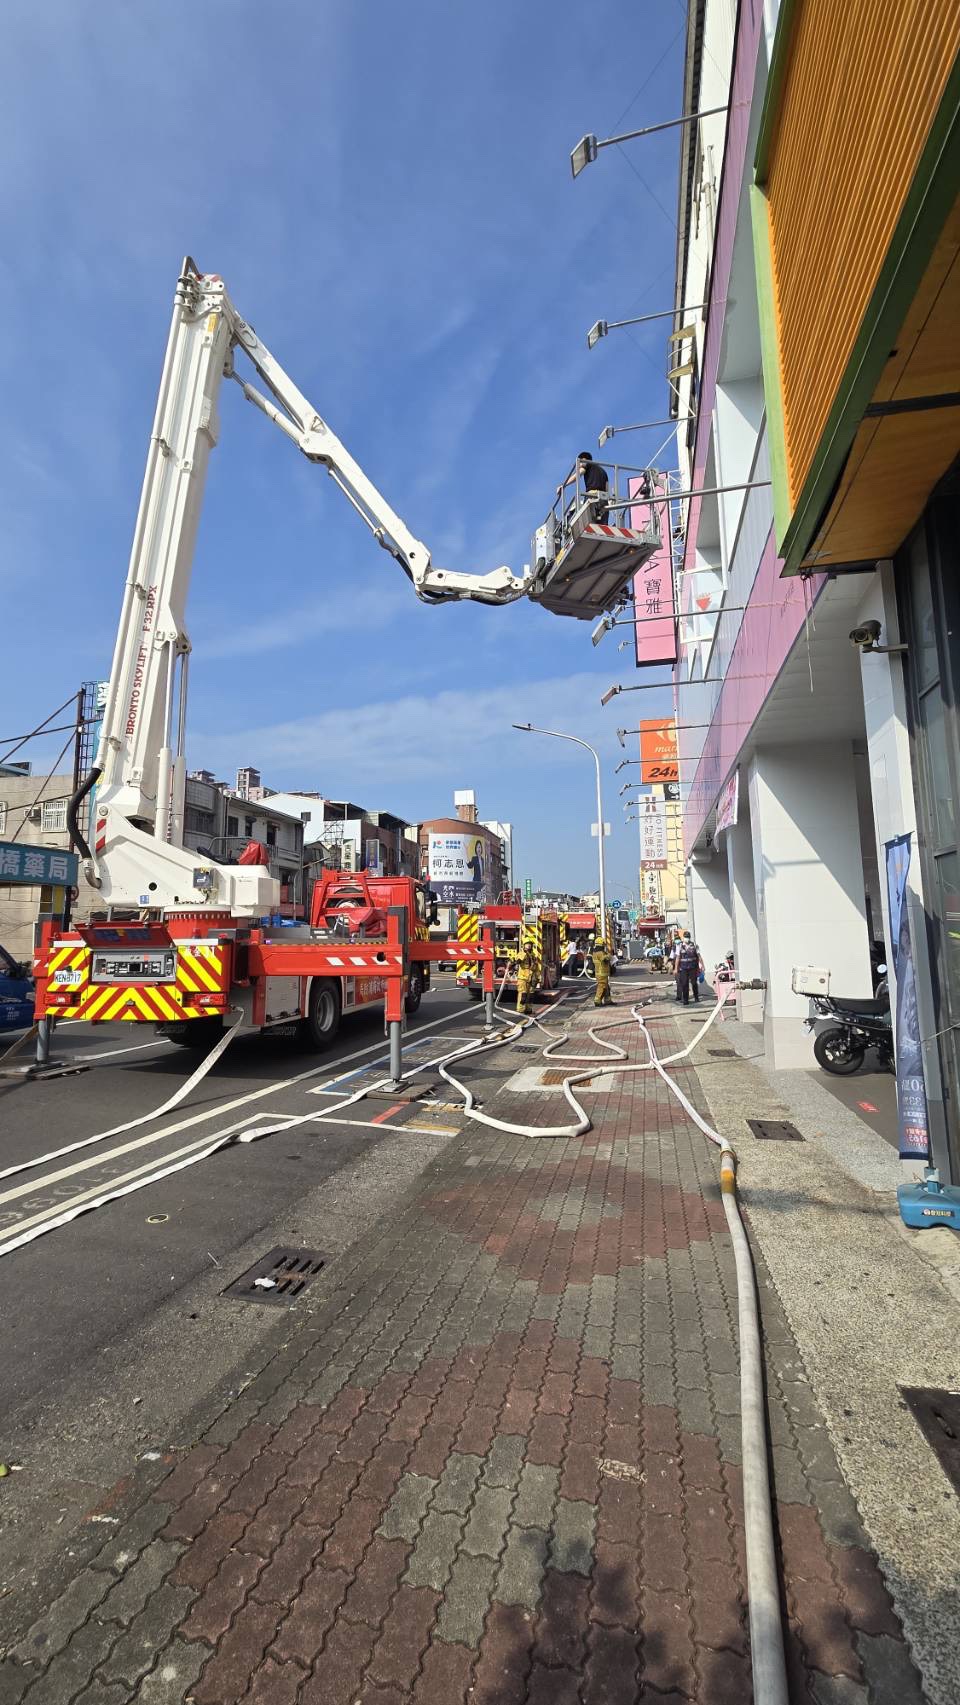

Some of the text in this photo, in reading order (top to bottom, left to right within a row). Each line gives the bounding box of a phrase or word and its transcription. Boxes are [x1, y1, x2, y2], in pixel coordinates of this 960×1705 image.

[126, 690, 140, 735] BRONTO
[133, 645, 148, 688] SKYLIFT
[0, 848, 68, 880] 橋藥局
[432, 858, 465, 869] 柯志恩
